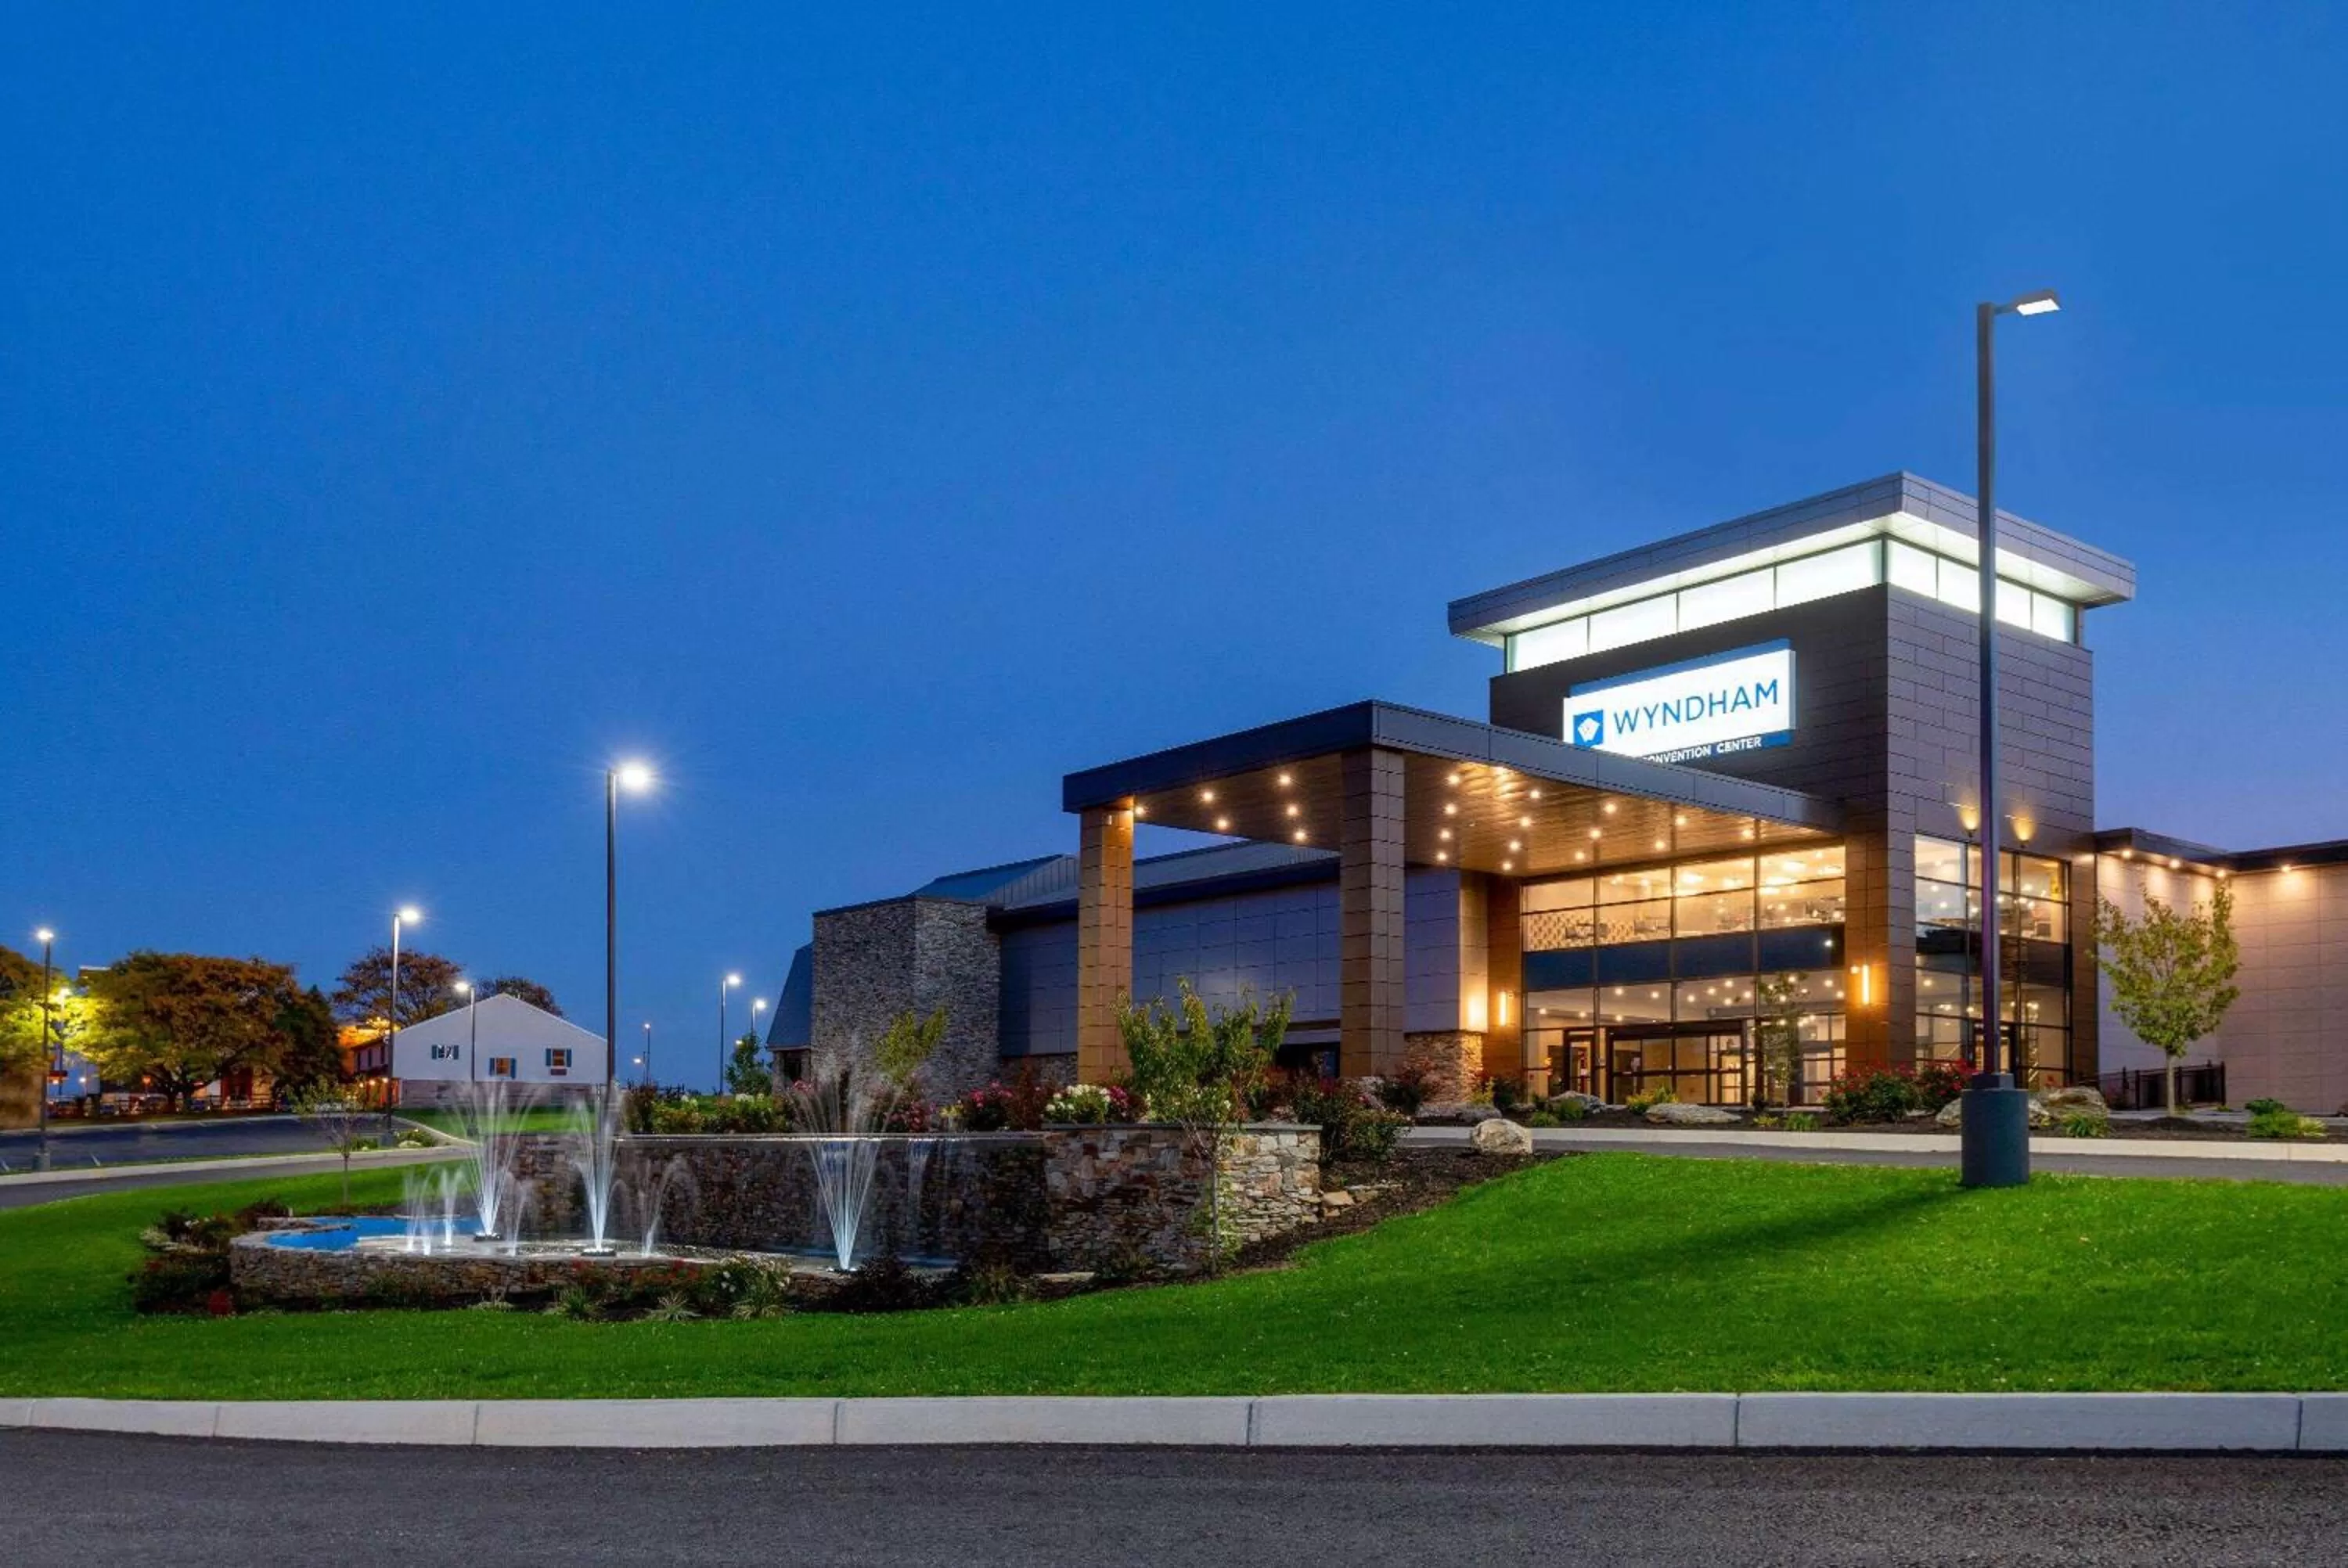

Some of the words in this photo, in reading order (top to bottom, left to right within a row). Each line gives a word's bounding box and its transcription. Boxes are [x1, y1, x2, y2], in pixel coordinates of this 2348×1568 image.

[1613, 678, 1778, 735] WYNDHAM
[1644, 745, 1712, 764] ONVENTION
[1716, 736, 1762, 754] CENTER
